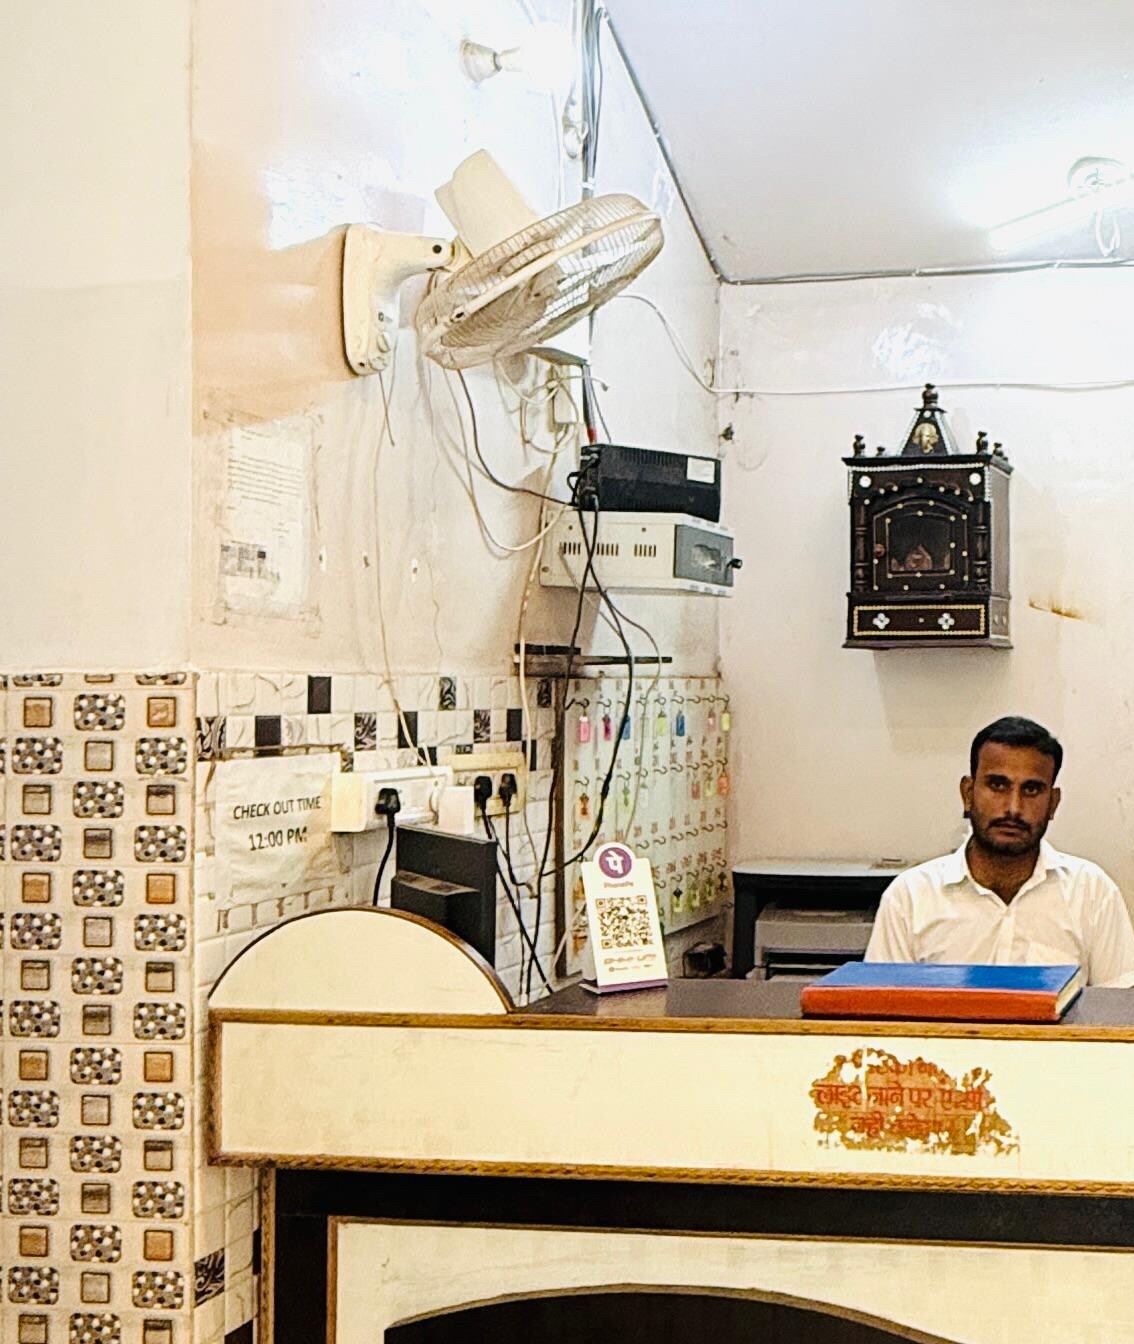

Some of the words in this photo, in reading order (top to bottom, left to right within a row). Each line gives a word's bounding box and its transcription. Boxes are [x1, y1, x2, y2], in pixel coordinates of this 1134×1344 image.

[233, 802, 270, 820] CHECK
[273, 799, 295, 815] OUT
[297, 795, 322, 811] TIME
[248, 828, 284, 851] 12:00
[908, 1087, 934, 1108] पर
